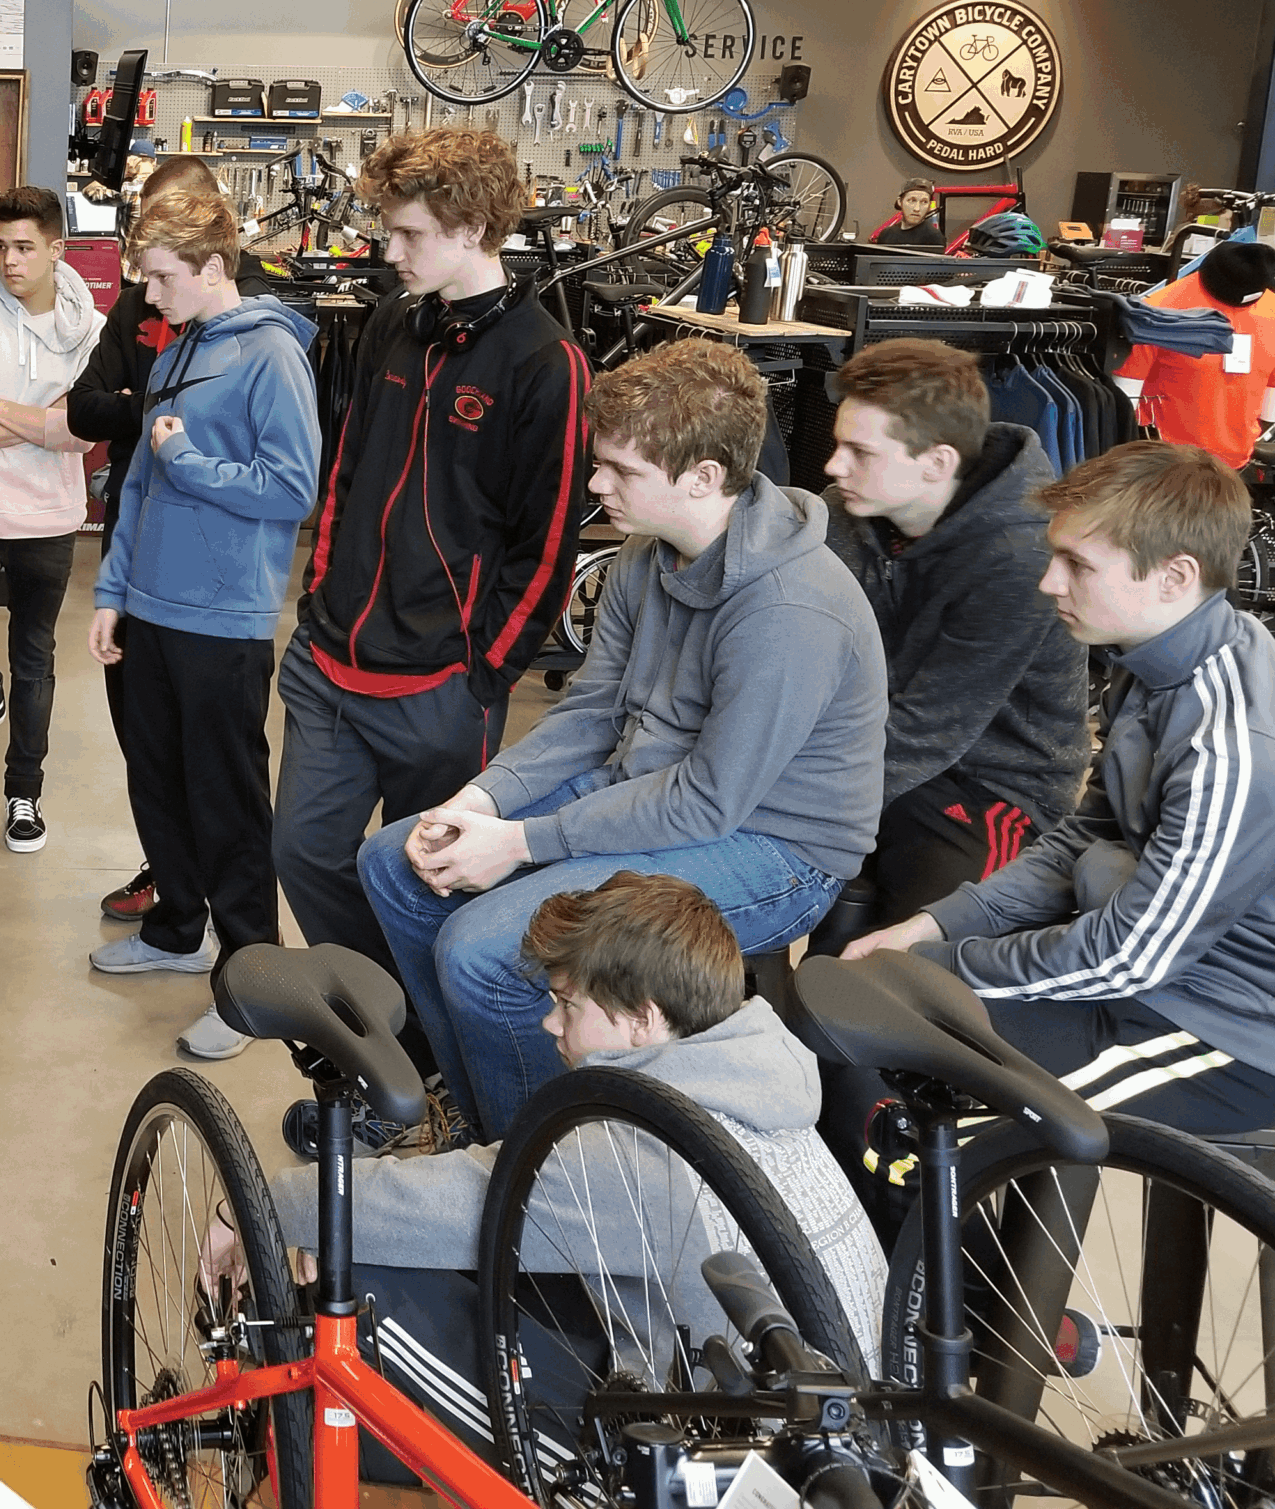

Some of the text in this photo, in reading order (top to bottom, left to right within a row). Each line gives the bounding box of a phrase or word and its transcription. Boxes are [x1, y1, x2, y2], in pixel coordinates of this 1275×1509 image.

[898, 5, 1052, 111] CARYTOWN BICYCLE COMPANY
[926, 139, 1004, 161] PEDAL HARD
[948, 128, 963, 136] RVA
[968, 129, 984, 137] USA
[337, 1154, 345, 1196] NTRAGER
[113, 1199, 131, 1300] CONNECTION
[810, 1224, 845, 1250] EGION
[496, 1349, 534, 1500] CONNECT
